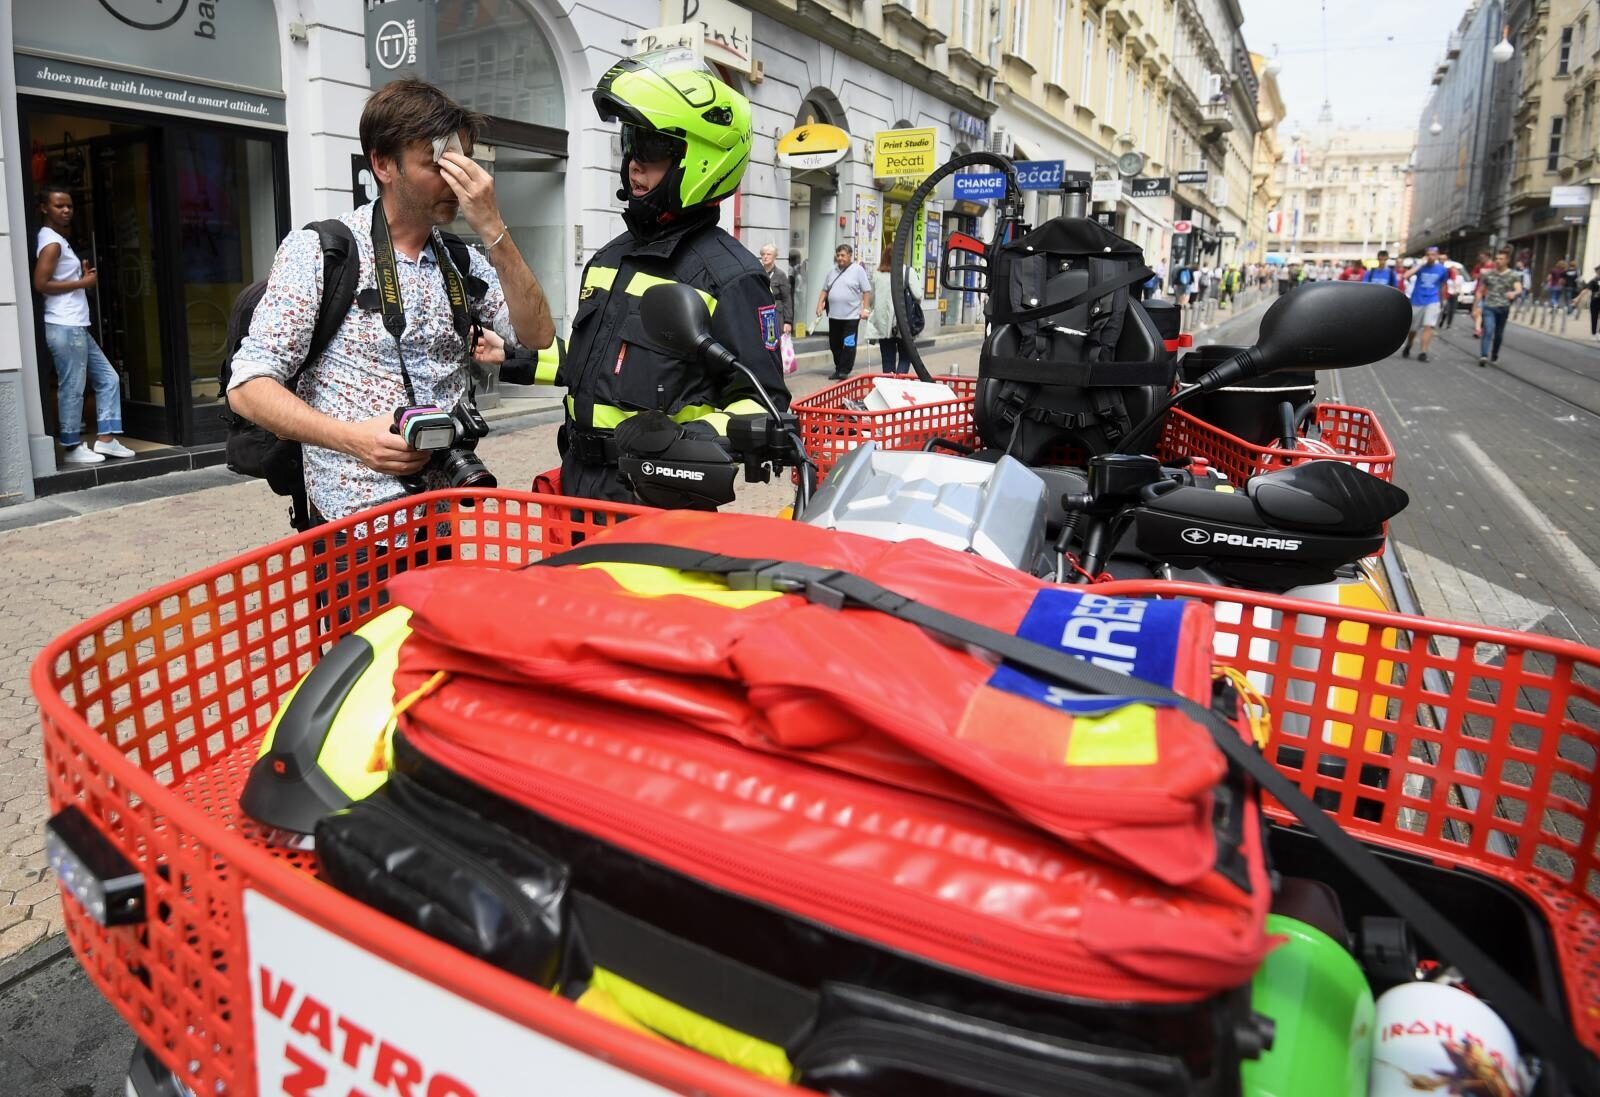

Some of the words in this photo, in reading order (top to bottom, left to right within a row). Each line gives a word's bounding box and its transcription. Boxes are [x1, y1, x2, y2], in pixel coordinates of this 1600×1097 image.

[194, 0, 221, 40] ba
[407, 19, 418, 64] bagatt
[36, 66, 72, 83] shoes
[74, 76, 109, 89] made
[110, 81, 137, 94] with
[139, 83, 163, 97] love
[164, 90, 188, 102] and
[188, 95, 196, 104] a
[197, 97, 229, 109] smart
[229, 100, 270, 116] attitude.
[883, 140, 903, 149] Print
[904, 138, 930, 148] Studio
[886, 155, 925, 167] Pečati
[957, 178, 1003, 188] CHANGE
[383, 268, 398, 304] Nikon
[447, 271, 463, 306] Nikon
[655, 466, 705, 481] POLARIS
[1213, 532, 1303, 551] POLARIS
